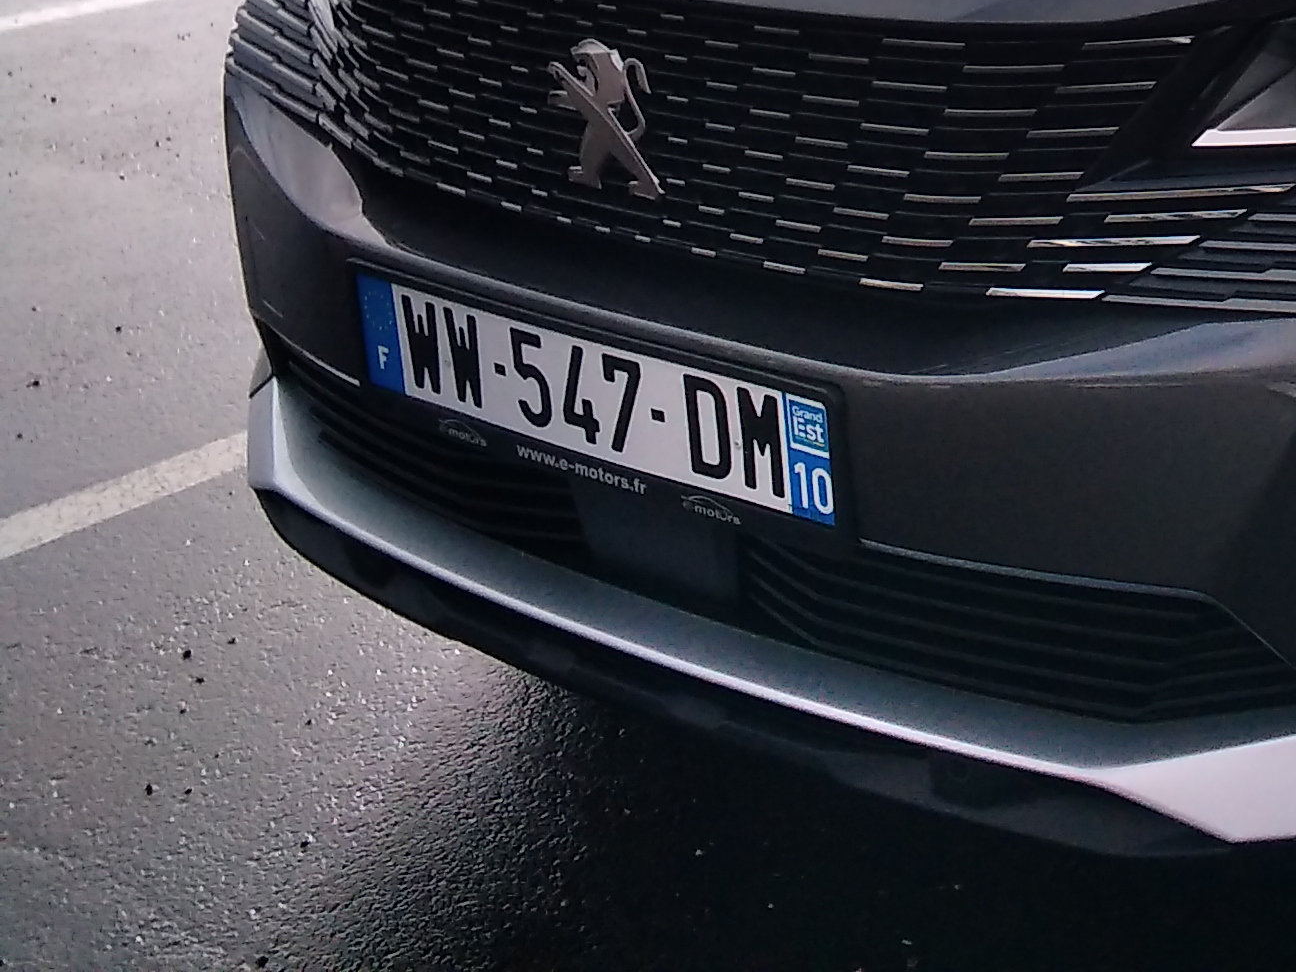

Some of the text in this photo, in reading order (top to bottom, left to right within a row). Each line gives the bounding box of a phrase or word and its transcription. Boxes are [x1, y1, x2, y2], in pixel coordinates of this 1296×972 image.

[376, 344, 389, 371] F
[402, 293, 787, 499] WW-547-DM
[792, 405, 824, 425] Grand
[793, 415, 825, 444] Est
[516, 442, 647, 496] www.e-motors.fr
[794, 462, 835, 515] 10
